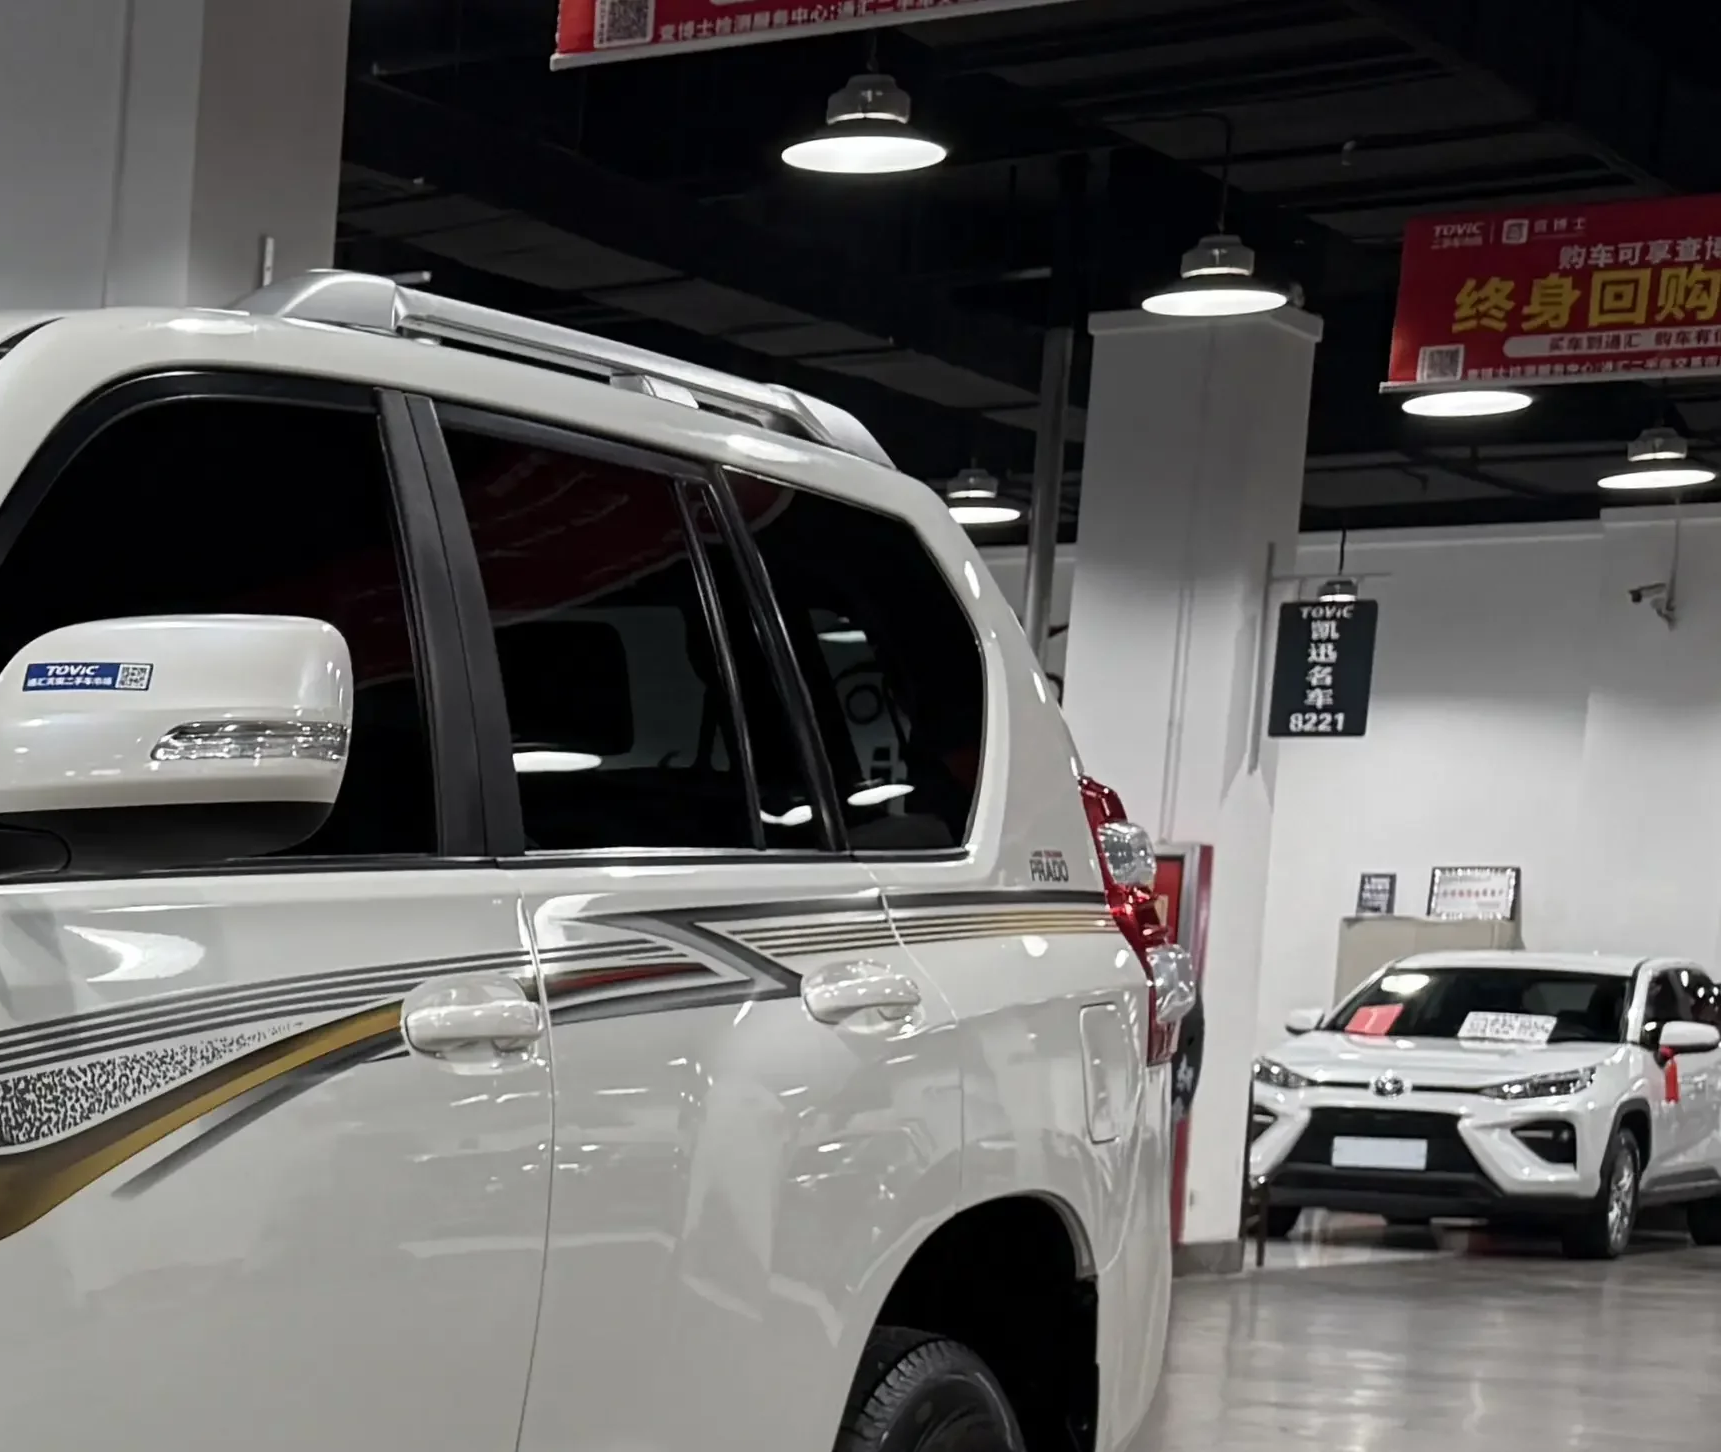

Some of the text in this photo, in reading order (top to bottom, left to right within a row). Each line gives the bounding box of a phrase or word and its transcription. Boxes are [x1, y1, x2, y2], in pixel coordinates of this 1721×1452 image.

[1452, 264, 1721, 333] 终身回购
[1289, 713, 1345, 732] 8221
[1030, 859, 1069, 882] PRADO
